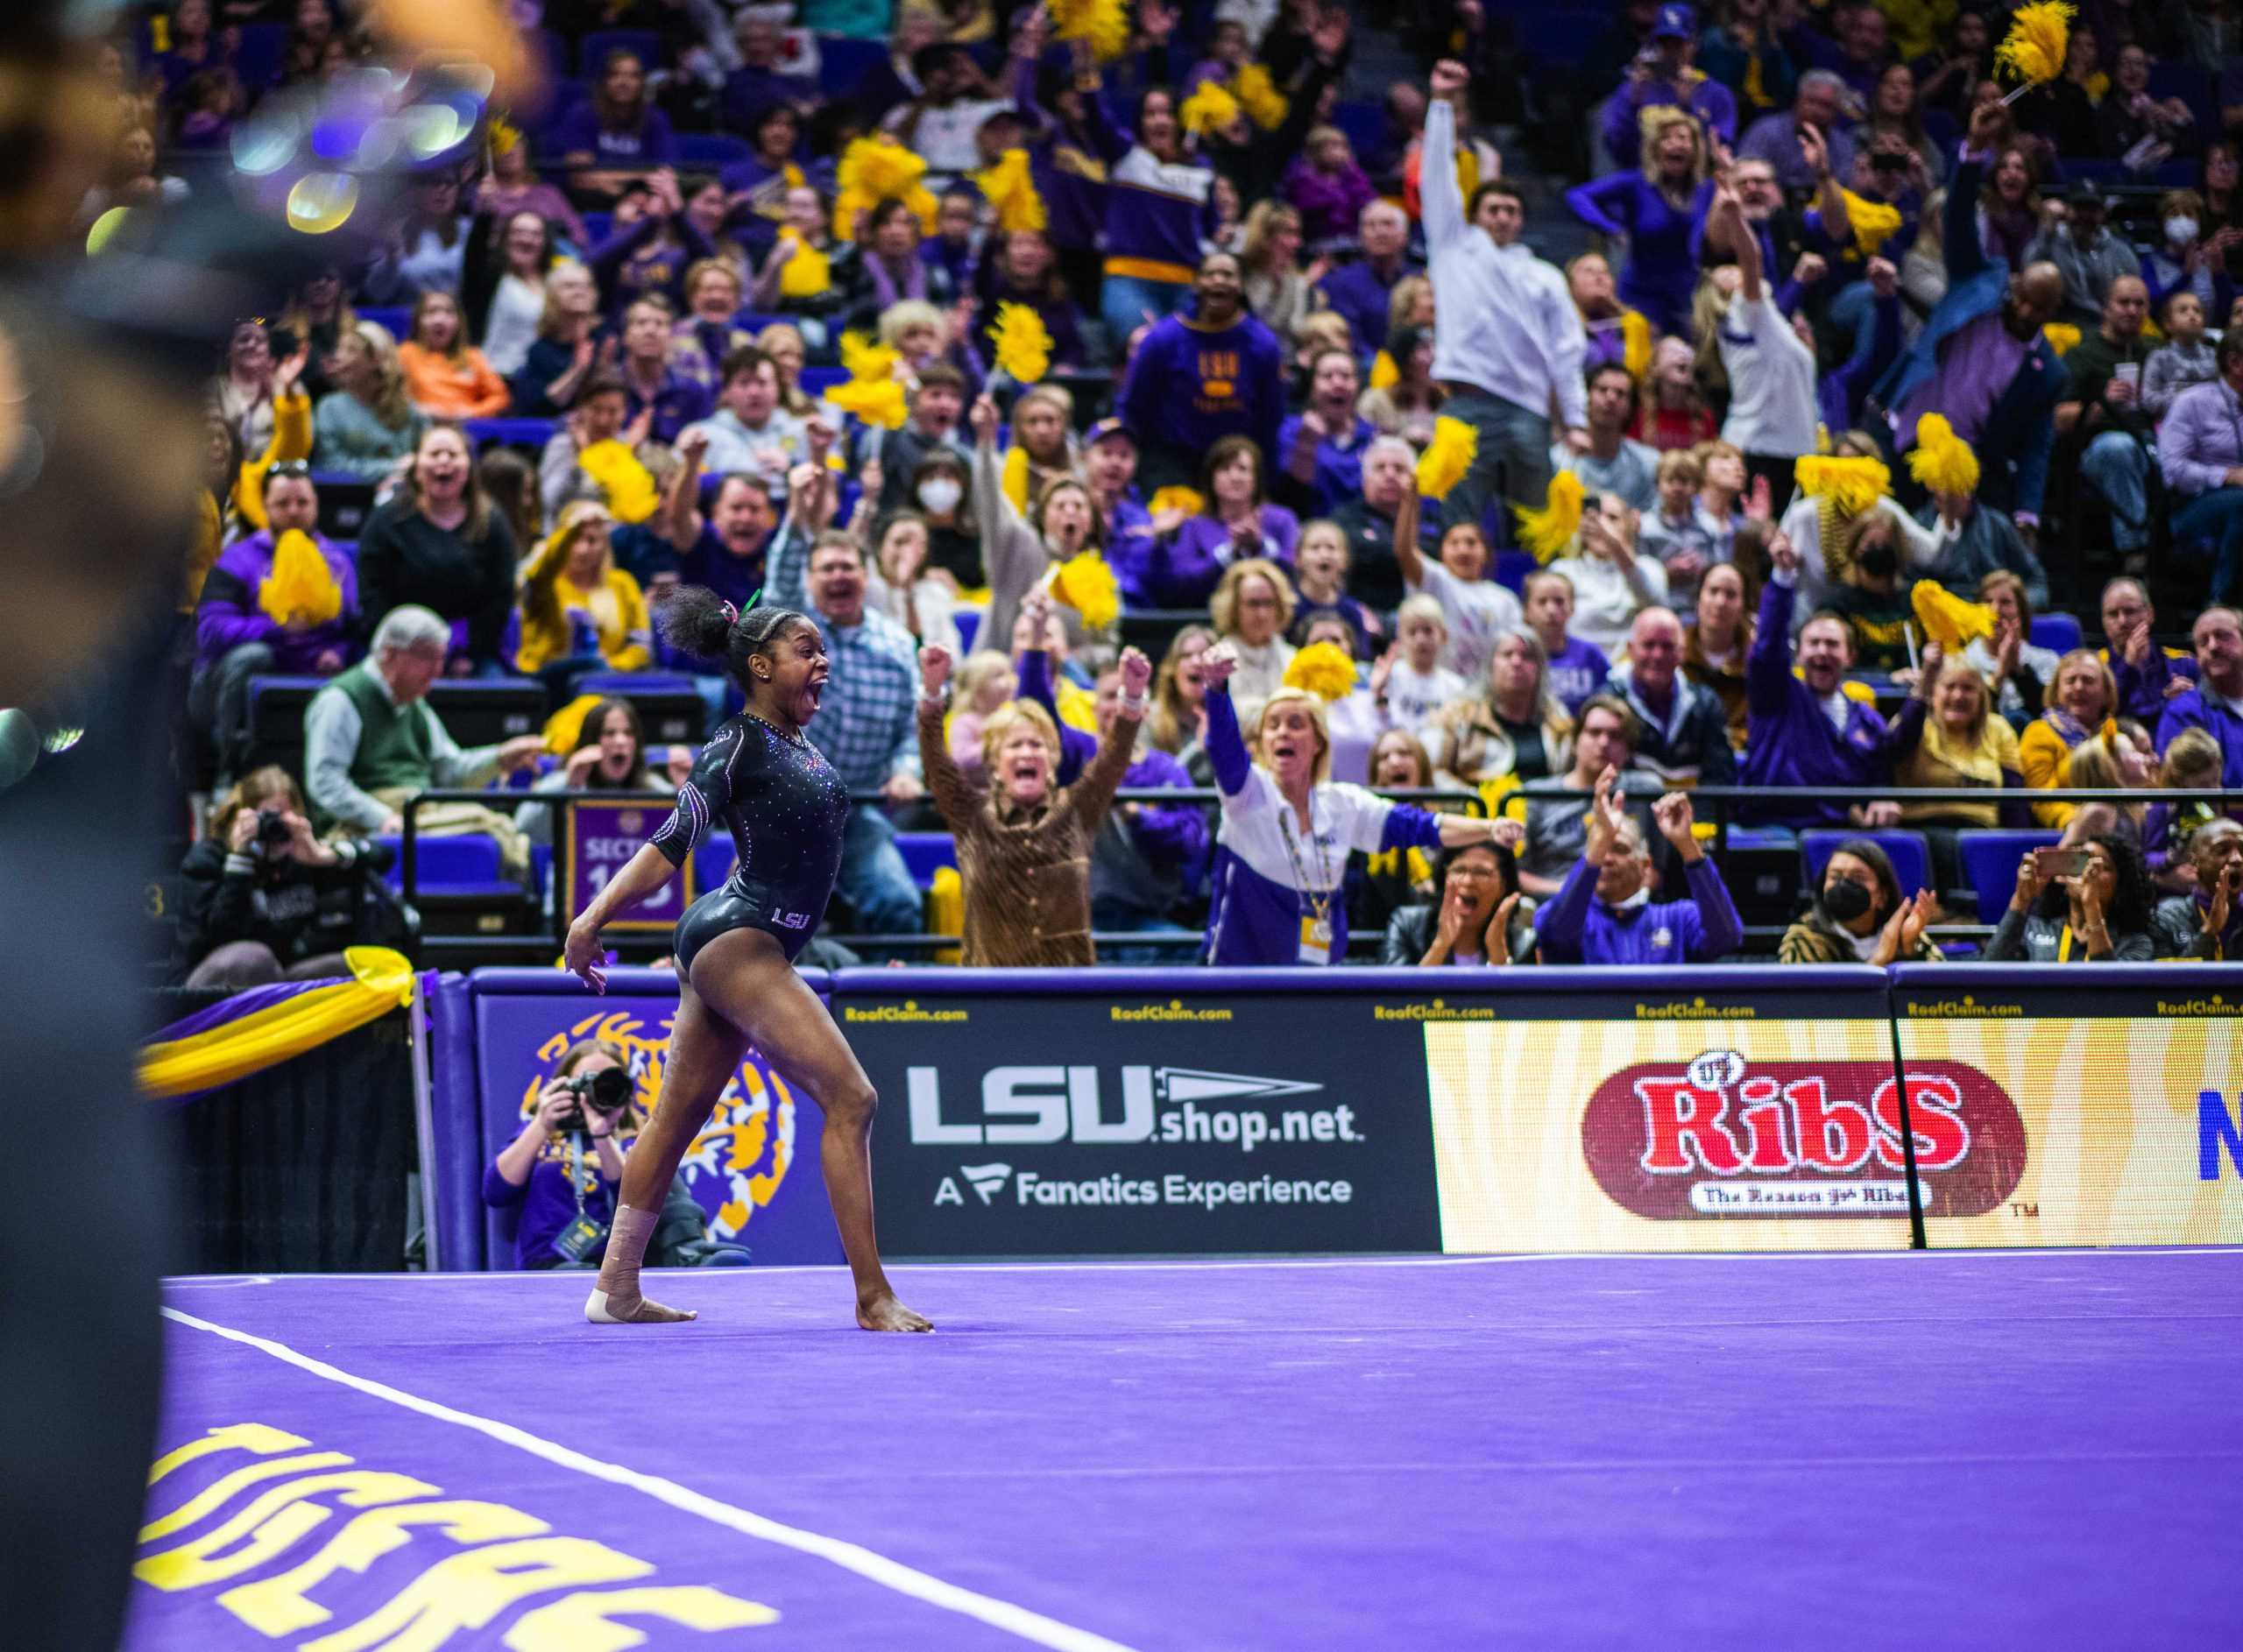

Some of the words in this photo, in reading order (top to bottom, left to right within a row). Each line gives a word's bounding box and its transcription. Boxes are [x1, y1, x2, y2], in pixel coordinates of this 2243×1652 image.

[1550, 668, 1594, 695] SU
[772, 907, 811, 929] LSU
[845, 1000, 968, 1022] RoofClaim.com
[1110, 999, 1233, 1021] RoofClaim.com
[1373, 998, 1495, 1020] RoofClaim.com
[1635, 997, 1755, 1019] RoofClaim.com
[1907, 995, 2023, 1017] RoofClaim.com
[933, 1176, 965, 1206] A
[1016, 1172, 1159, 1205] Fanatics
[1163, 1174, 1352, 1211] Experience
